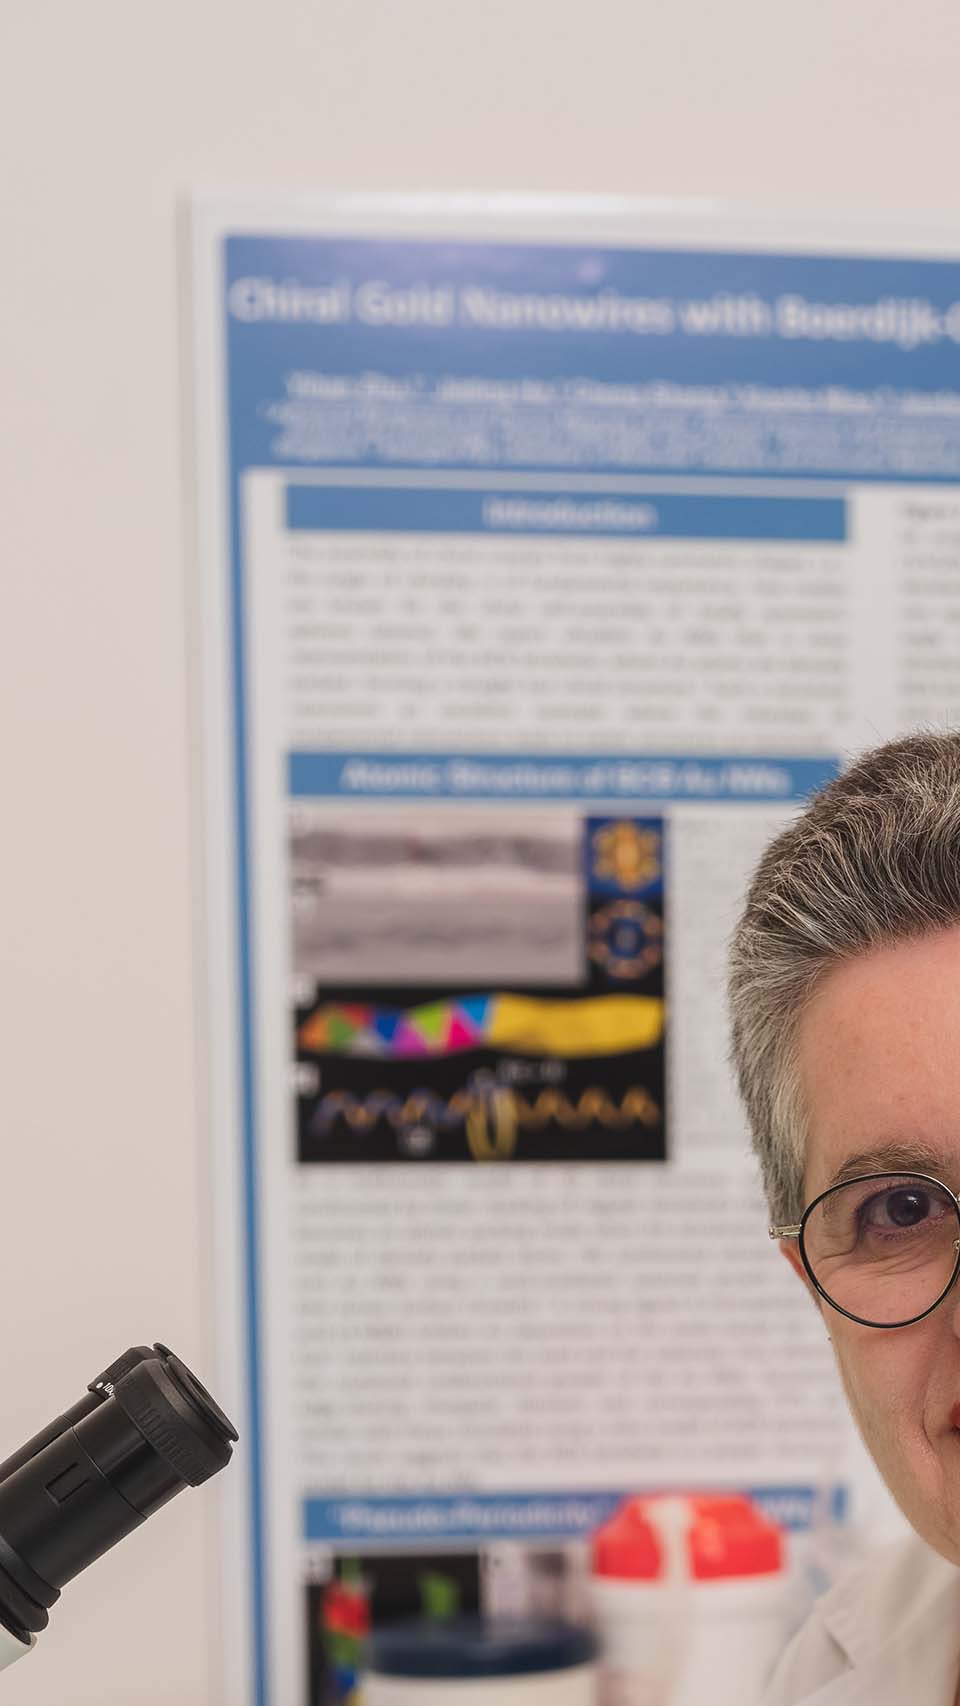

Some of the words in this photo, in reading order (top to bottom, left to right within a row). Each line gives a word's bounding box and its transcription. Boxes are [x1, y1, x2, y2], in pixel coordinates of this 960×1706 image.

[230, 277, 348, 324] Chiral
[354, 281, 453, 326] Gold
[459, 284, 674, 334] Nanowires
[681, 289, 769, 336] with
[484, 497, 656, 529] Introduction
